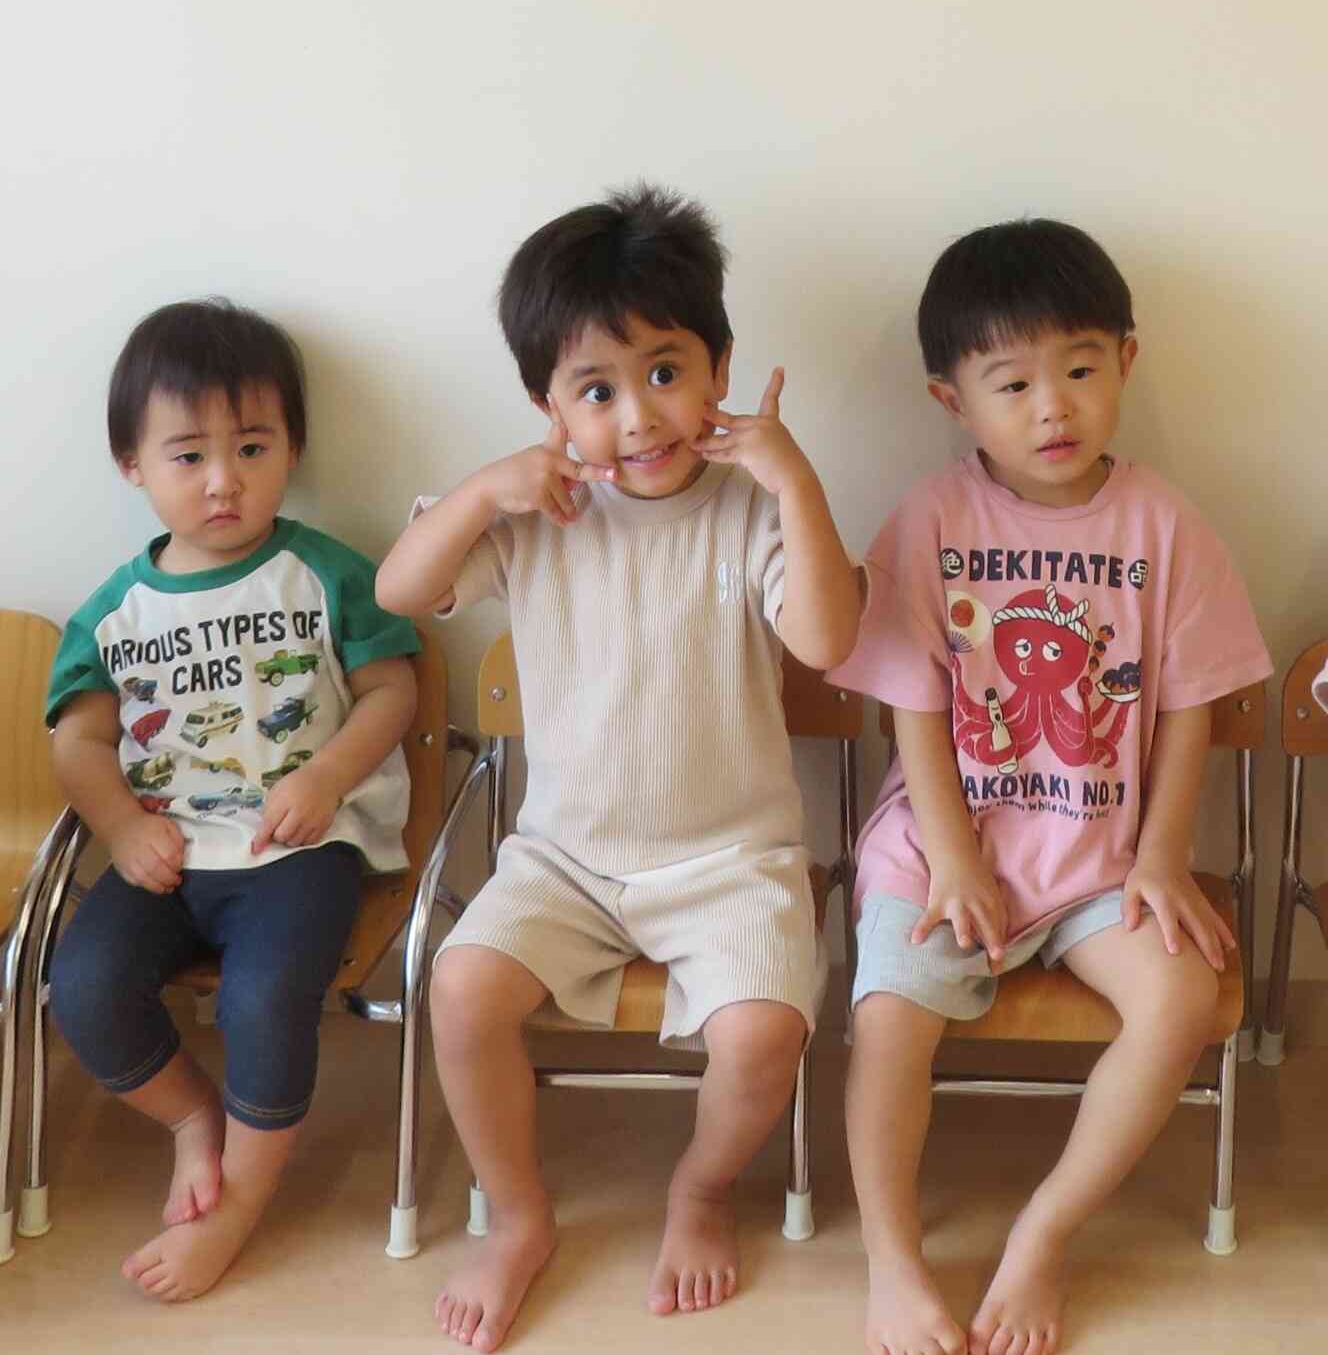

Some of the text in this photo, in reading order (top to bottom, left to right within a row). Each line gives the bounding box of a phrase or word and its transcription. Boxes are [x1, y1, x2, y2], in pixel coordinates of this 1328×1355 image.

[968, 548, 1124, 588] DEKITATE
[198, 610, 286, 652] TYPES
[292, 610, 323, 640] OF
[171, 655, 243, 695] CARS
[963, 772, 1126, 807] AKOYAKI NO.1
